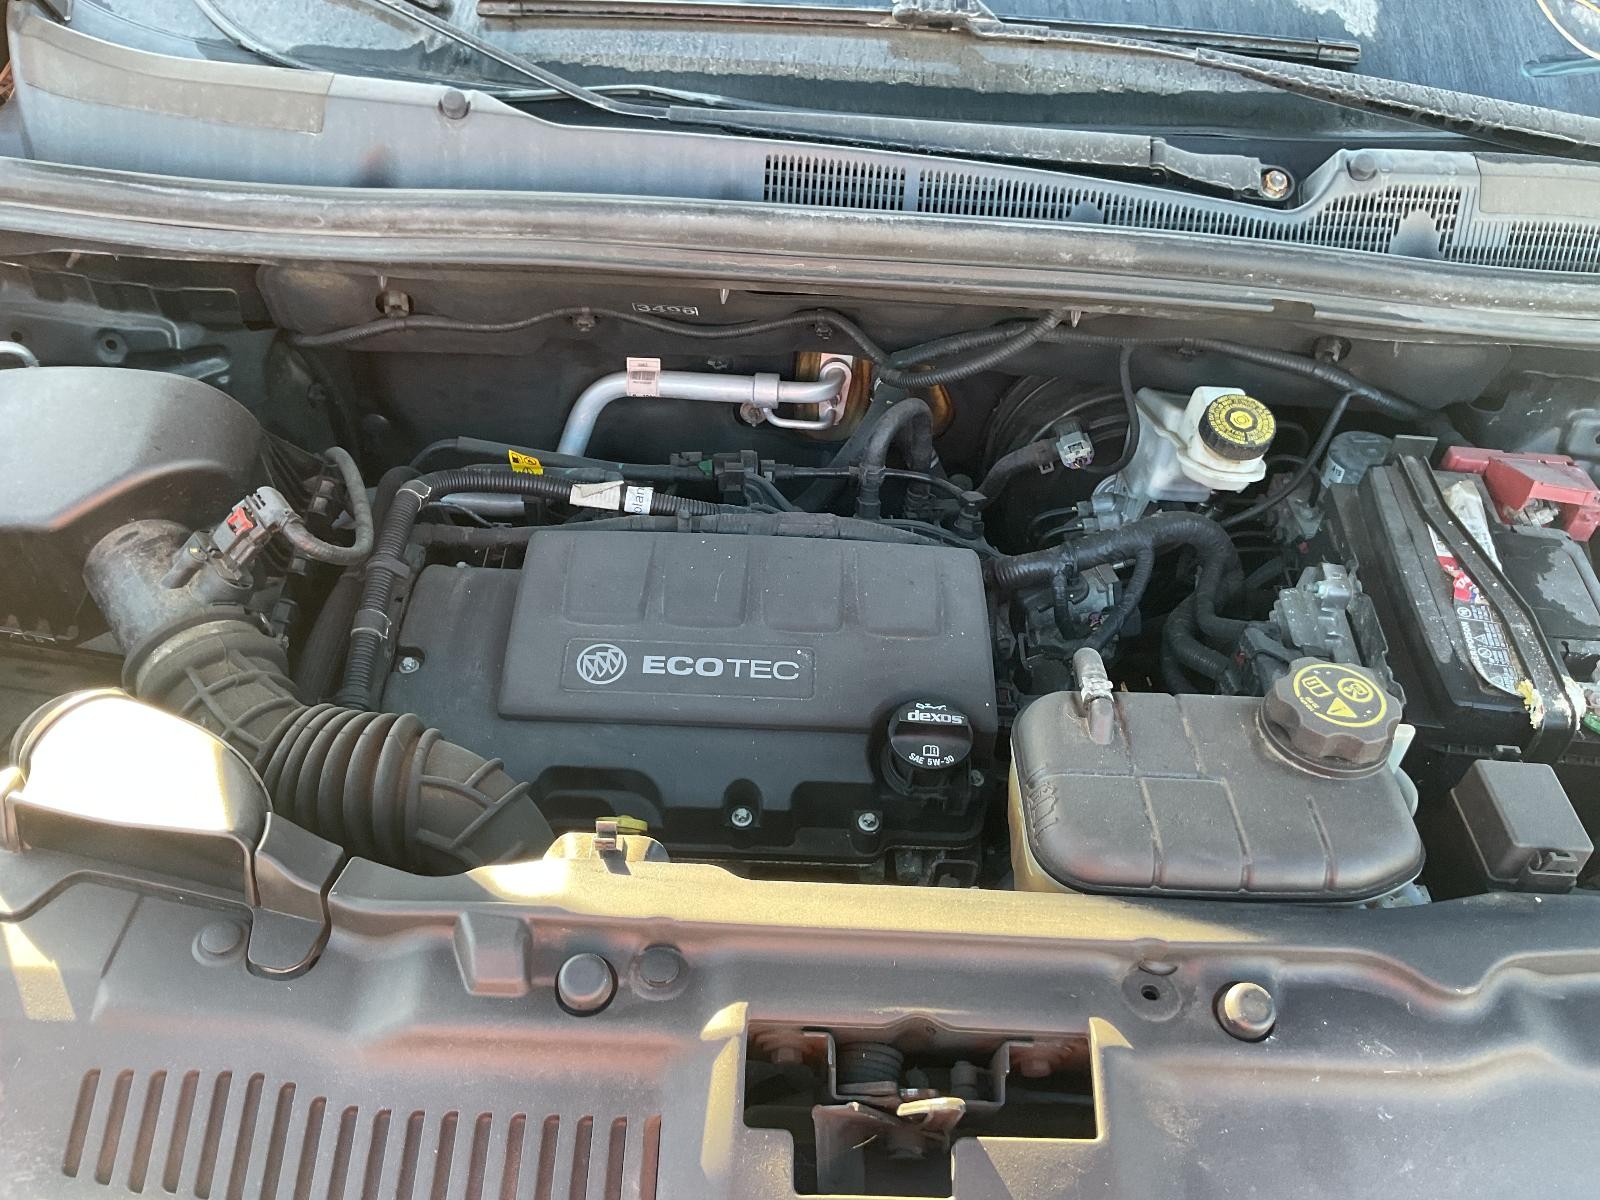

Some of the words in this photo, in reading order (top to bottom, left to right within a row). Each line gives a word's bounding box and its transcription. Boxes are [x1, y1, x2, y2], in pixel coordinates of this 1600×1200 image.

[642, 655, 800, 680] ECOTEC
[907, 709, 963, 724] dexos
[908, 752, 925, 765] SAE
[927, 755, 955, 766] 5W-30
